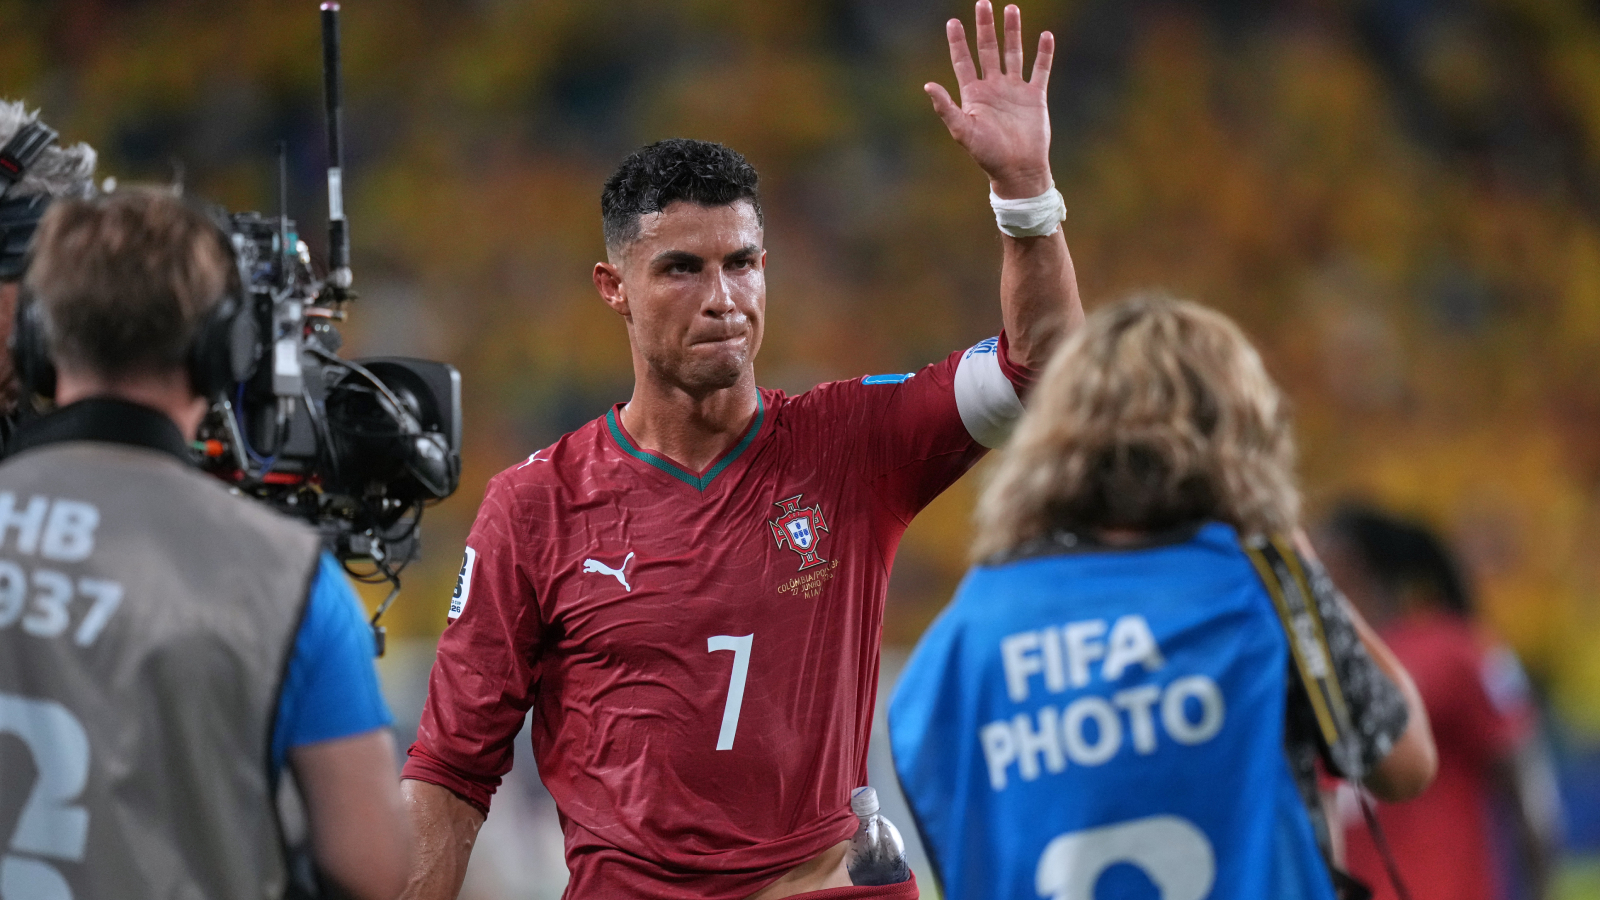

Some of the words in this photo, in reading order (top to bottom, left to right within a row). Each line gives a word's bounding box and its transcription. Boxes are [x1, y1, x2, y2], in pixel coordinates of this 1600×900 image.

[707, 633, 754, 750] 7
[1002, 614, 1165, 702] FIFA
[980, 674, 1226, 791] PHOTO
